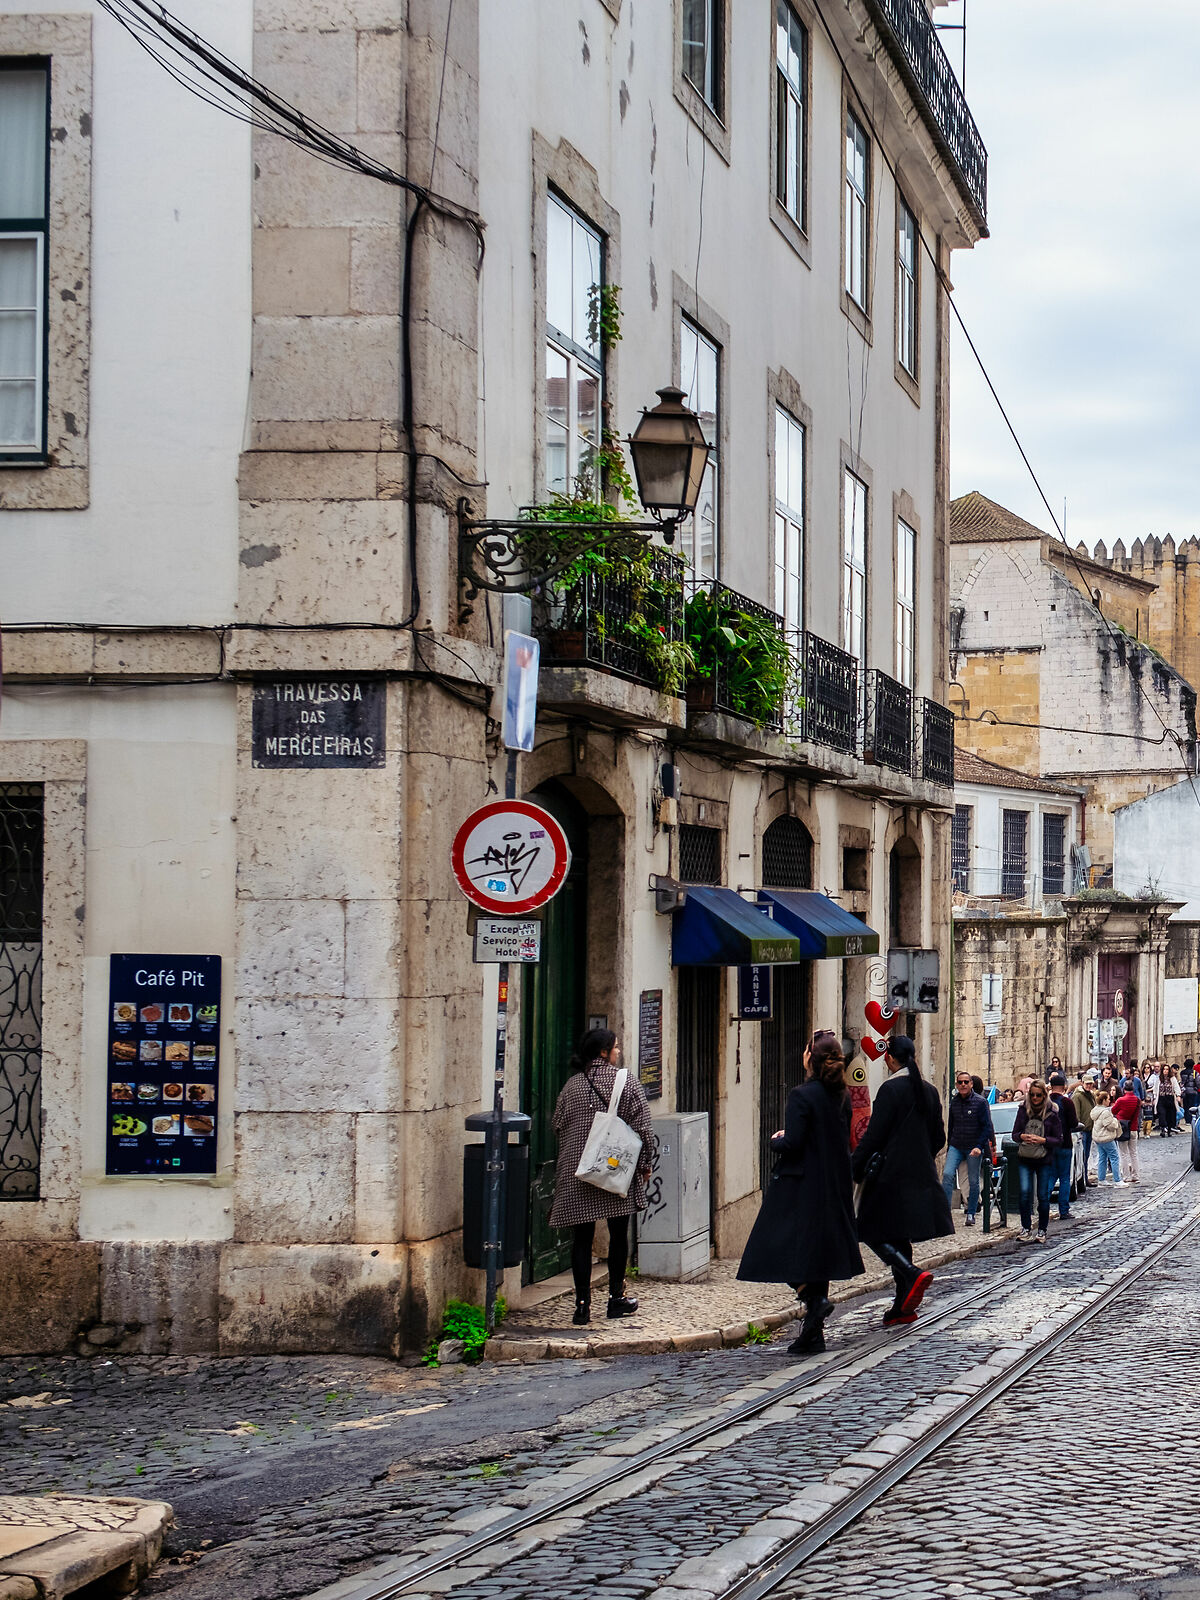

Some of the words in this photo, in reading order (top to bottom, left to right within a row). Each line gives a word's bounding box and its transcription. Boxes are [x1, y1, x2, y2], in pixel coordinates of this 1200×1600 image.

[273, 682, 363, 701] TRAVESSA
[300, 710, 327, 724] DAS
[265, 737, 375, 756] MERCEEIRAS
[490, 924, 519, 934] Excep
[482, 936, 518, 947] Serviço
[524, 937, 536, 945] de
[135, 970, 176, 986] Café
[182, 970, 205, 987] Pit
[744, 1005, 769, 1013] CAFÉ
